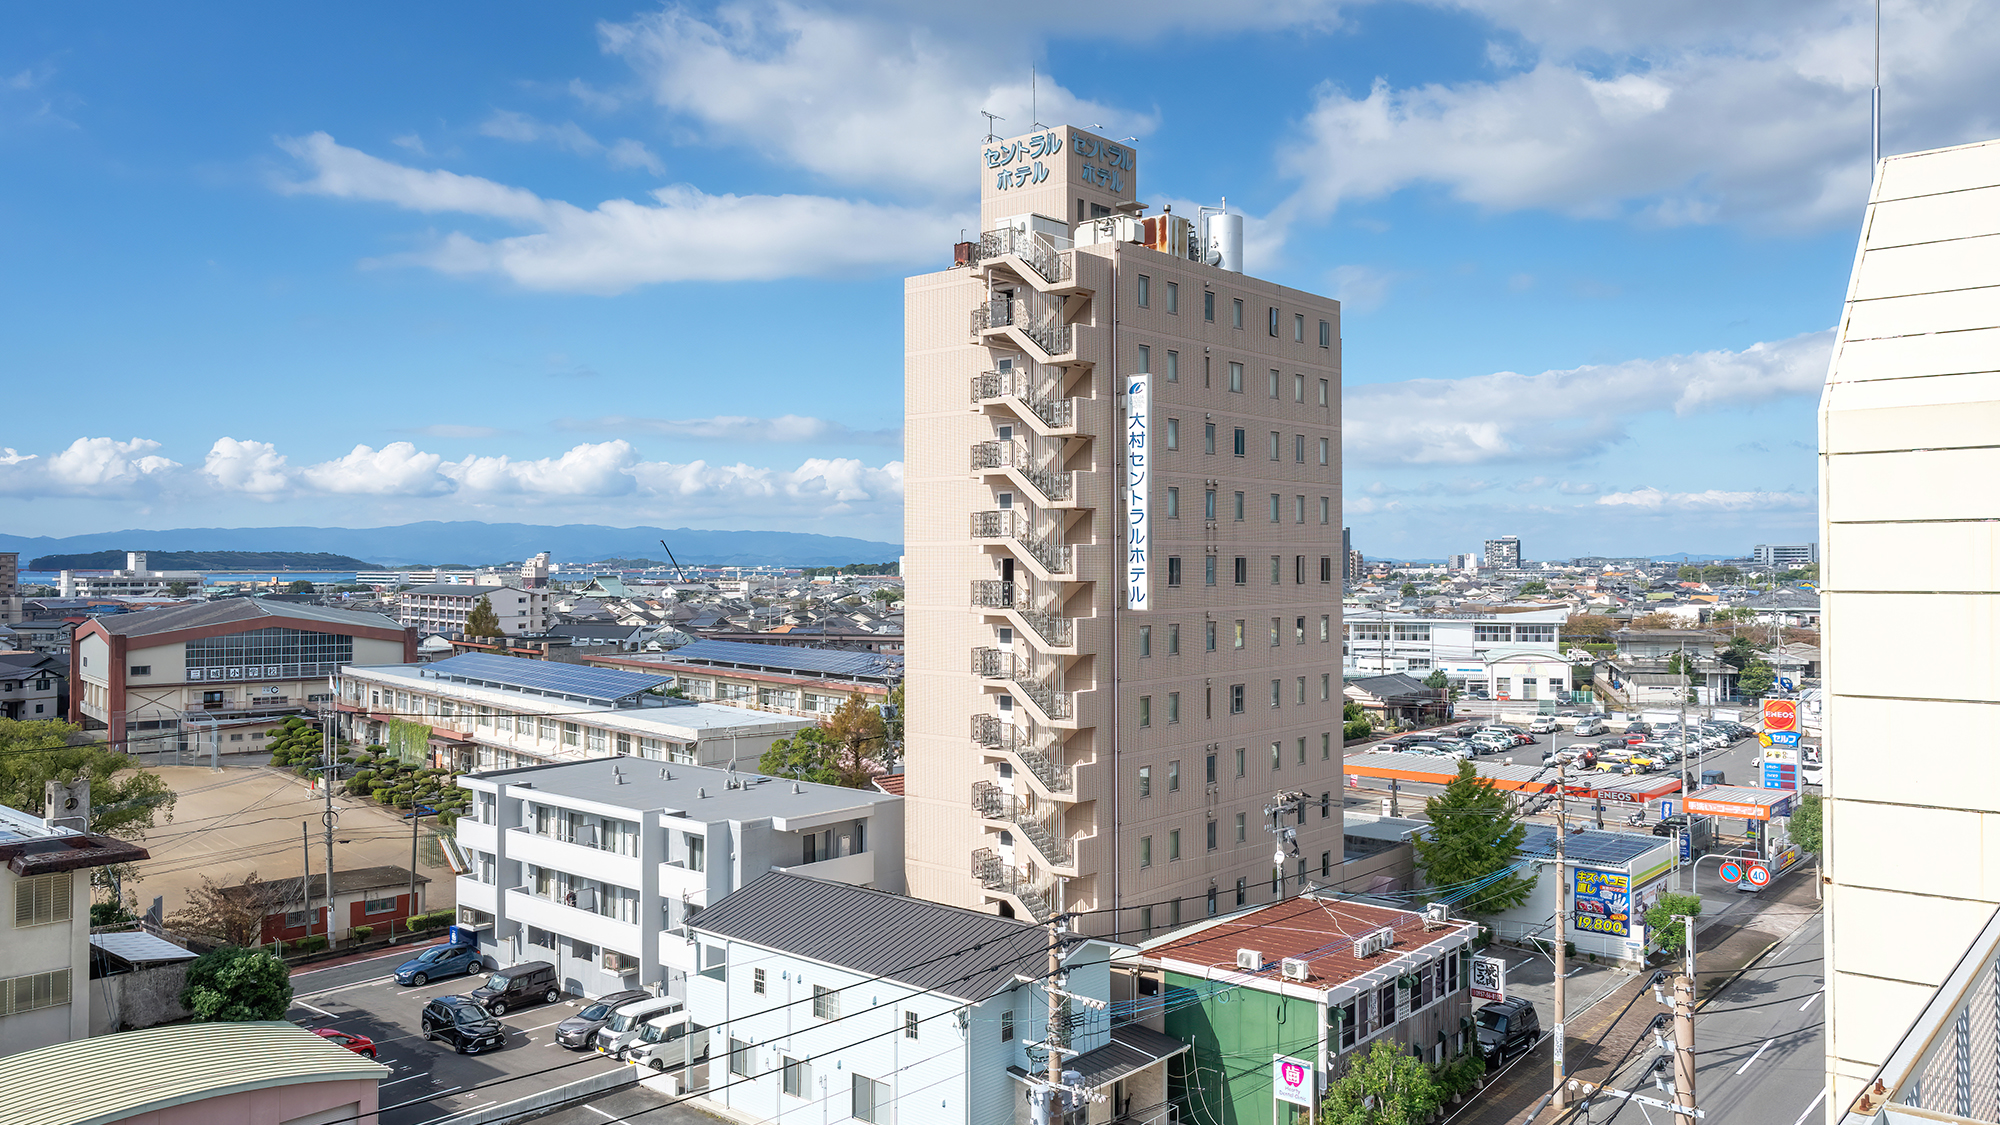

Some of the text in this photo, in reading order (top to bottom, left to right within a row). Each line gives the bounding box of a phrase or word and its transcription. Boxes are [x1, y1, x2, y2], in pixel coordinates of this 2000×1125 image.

[984, 133, 1063, 168] セントラル
[1072, 132, 1133, 171] セントラル
[997, 161, 1049, 190] ホテル
[1082, 162, 1124, 192] ホテル
[1128, 412, 1146, 602] 大村セントラルホテル
[1772, 733, 1797, 744] セルフ
[1598, 791, 1632, 801] ENEOS
[1576, 871, 1628, 887] キズ・ヘコミ
[1752, 872, 1764, 880] 40
[1577, 882, 1596, 893] 直し
[1285, 1066, 1300, 1084] 歯
